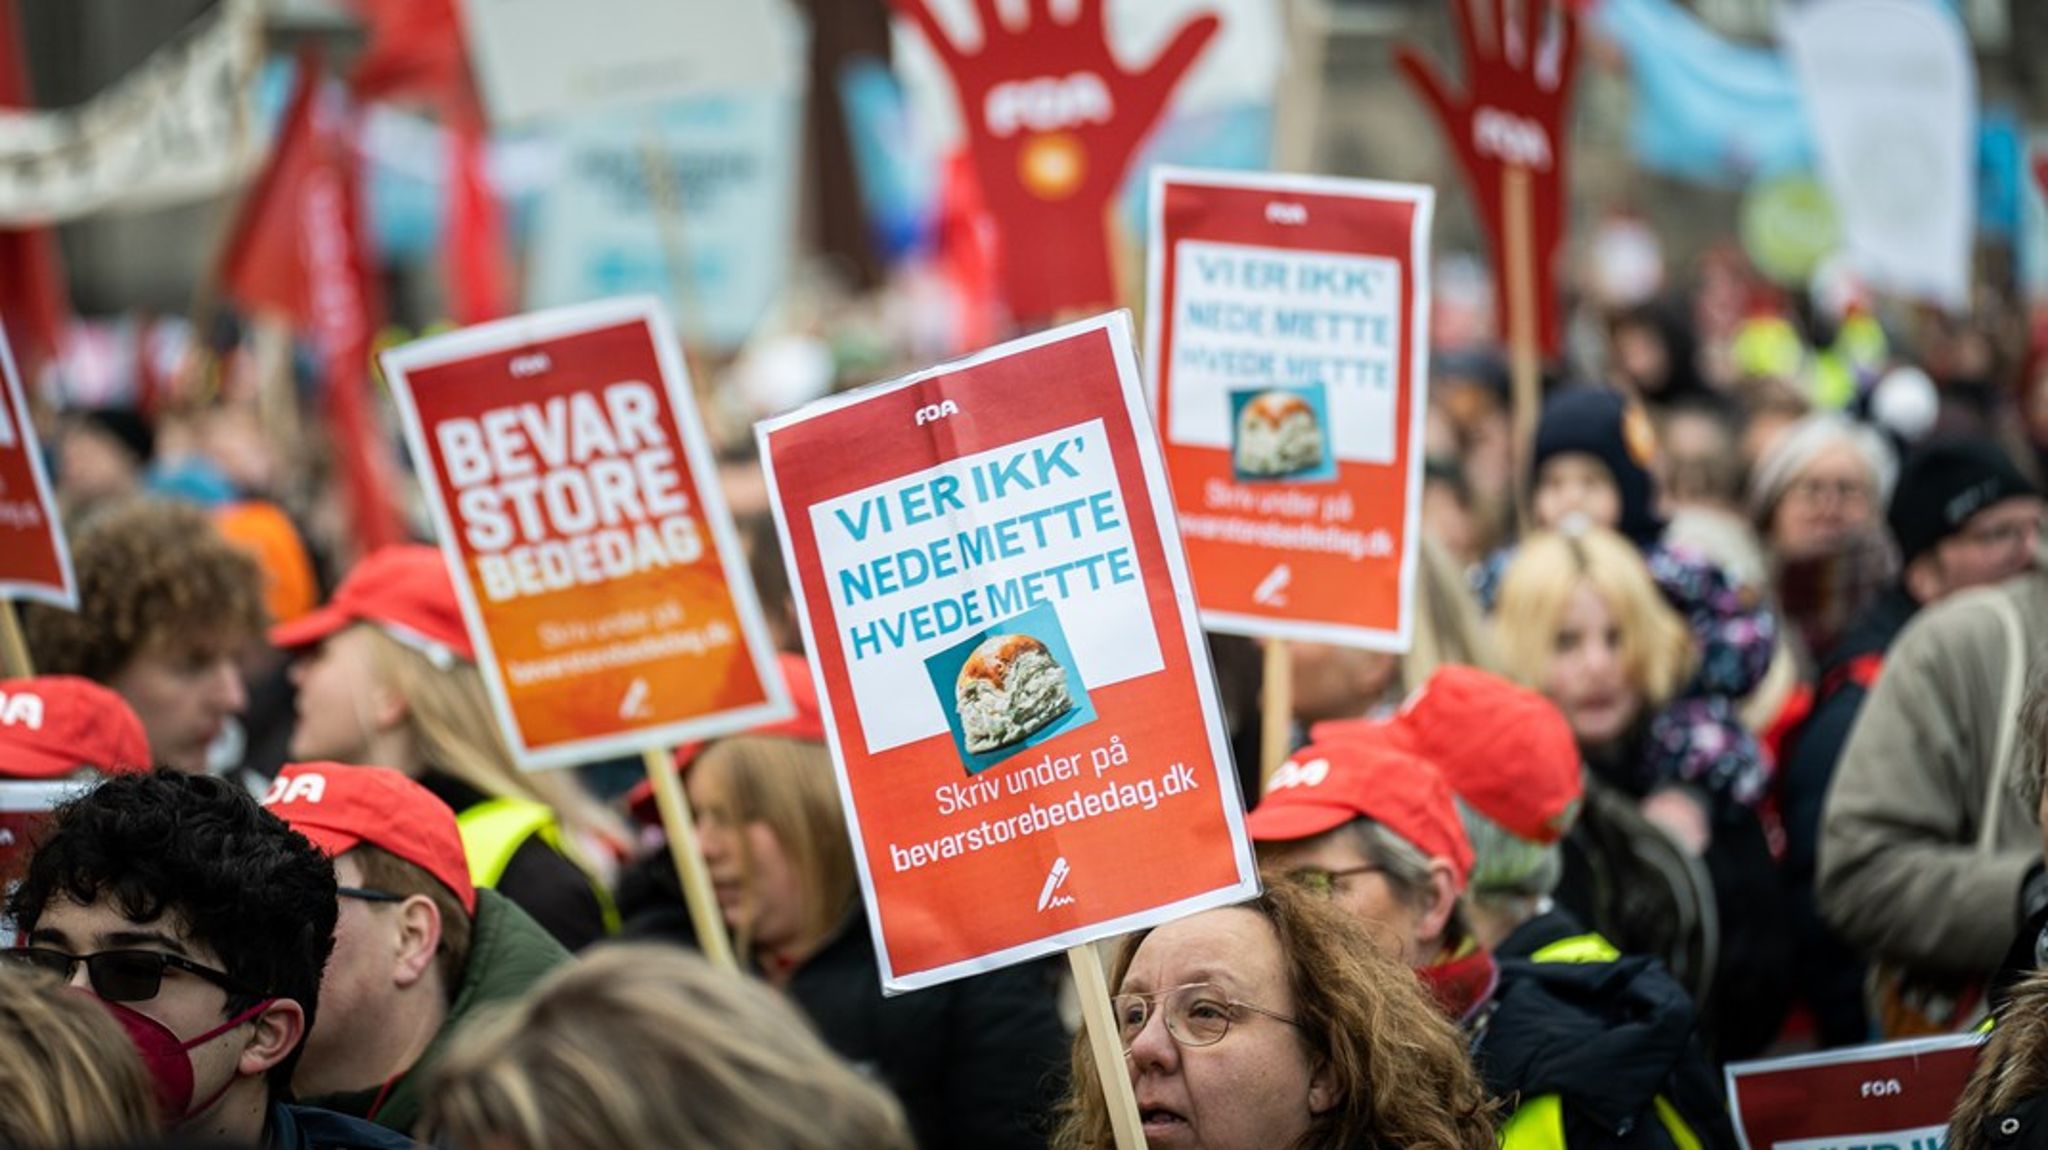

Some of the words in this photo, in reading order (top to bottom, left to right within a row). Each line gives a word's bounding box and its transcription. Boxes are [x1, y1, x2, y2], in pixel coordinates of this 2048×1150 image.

[1196, 255, 1234, 286] VI
[1243, 259, 1288, 291] ER
[1187, 301, 1264, 336] NEDE
[1274, 307, 1387, 346] METTE
[435, 380, 668, 488] BEVAR
[914, 399, 960, 426] FOA
[458, 448, 689, 550] STORE
[834, 495, 893, 542] VI
[899, 474, 966, 527] ER
[476, 515, 702, 599] BEDEDAG
[838, 536, 958, 606] NEDE
[957, 490, 1121, 569] METTE
[850, 588, 984, 660] HVEDE
[985, 546, 1136, 618] METTE
[260, 772, 326, 806] OA
[934, 777, 1001, 816] Skriv
[1005, 753, 1083, 795] under
[1091, 735, 1130, 778] på
[889, 762, 1199, 873] bevarstorebededag.dk
[1861, 1078, 1902, 1098] FOA
